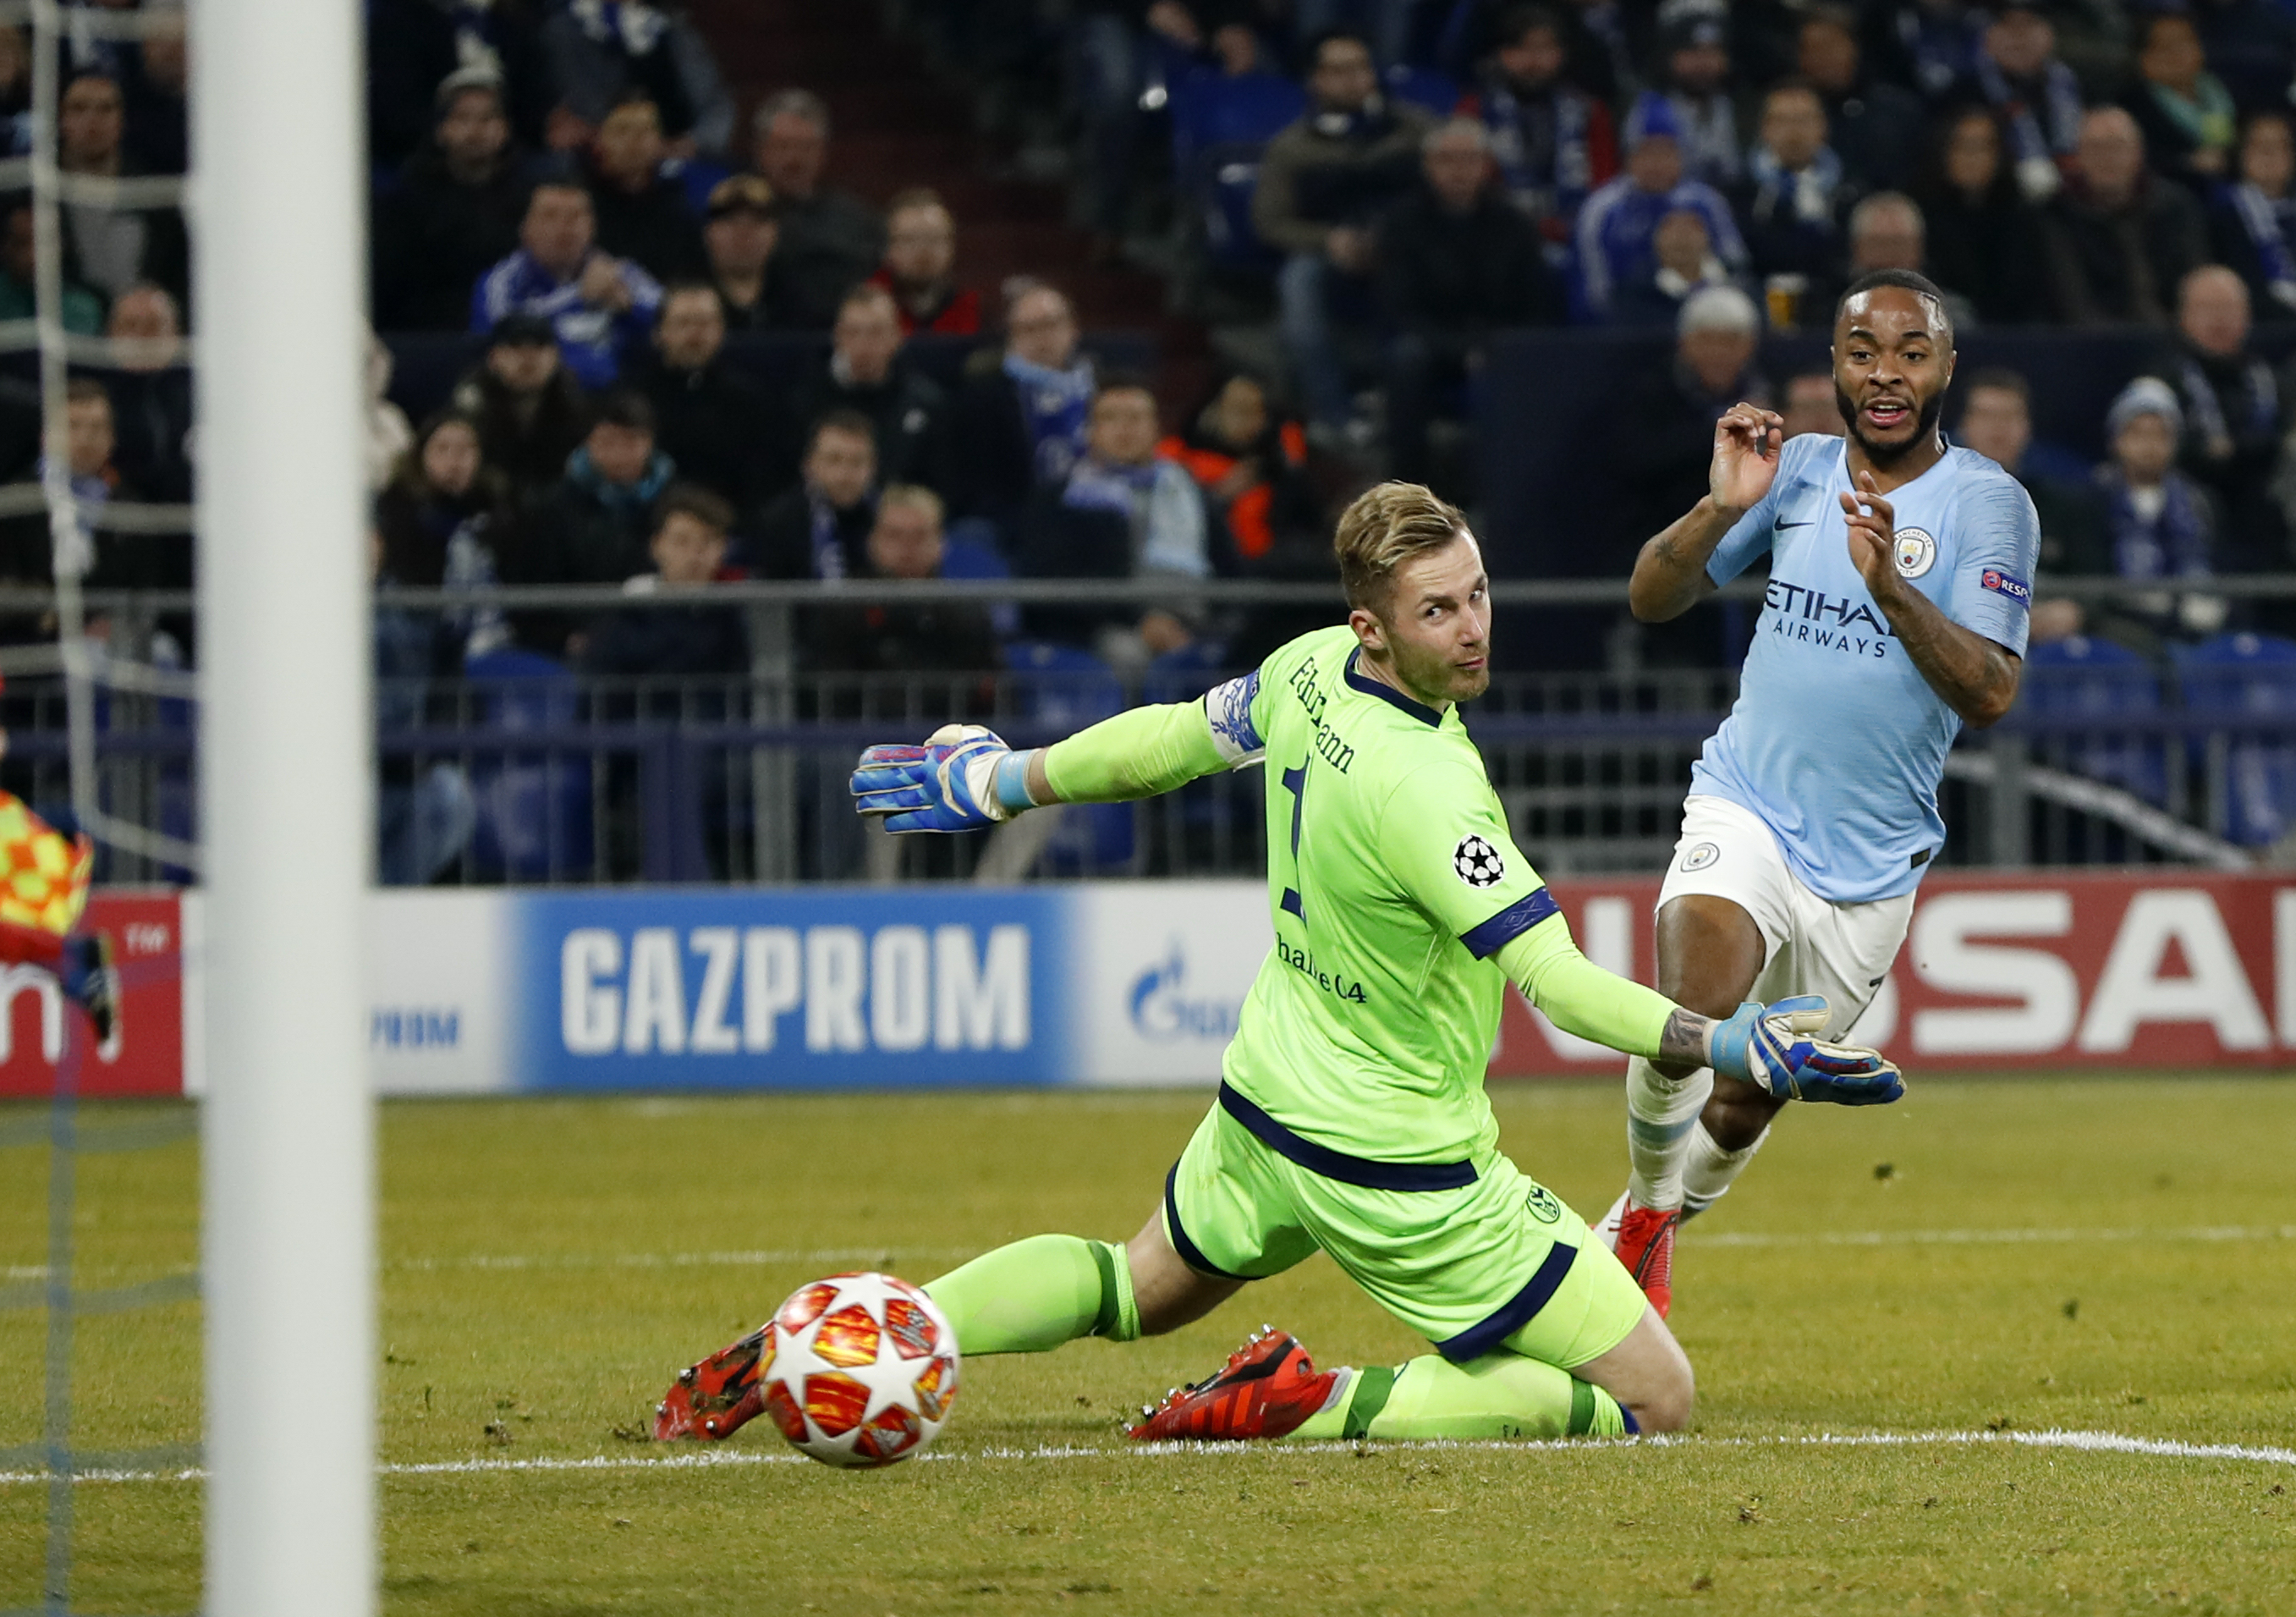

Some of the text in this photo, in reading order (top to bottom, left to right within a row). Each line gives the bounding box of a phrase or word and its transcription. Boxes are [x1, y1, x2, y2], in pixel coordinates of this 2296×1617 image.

[1766, 578, 1898, 638] ETIHA
[2002, 579, 2029, 597] RESP
[1773, 618, 1887, 658] AIRWAYS
[562, 926, 1030, 1055] GAZPROM
